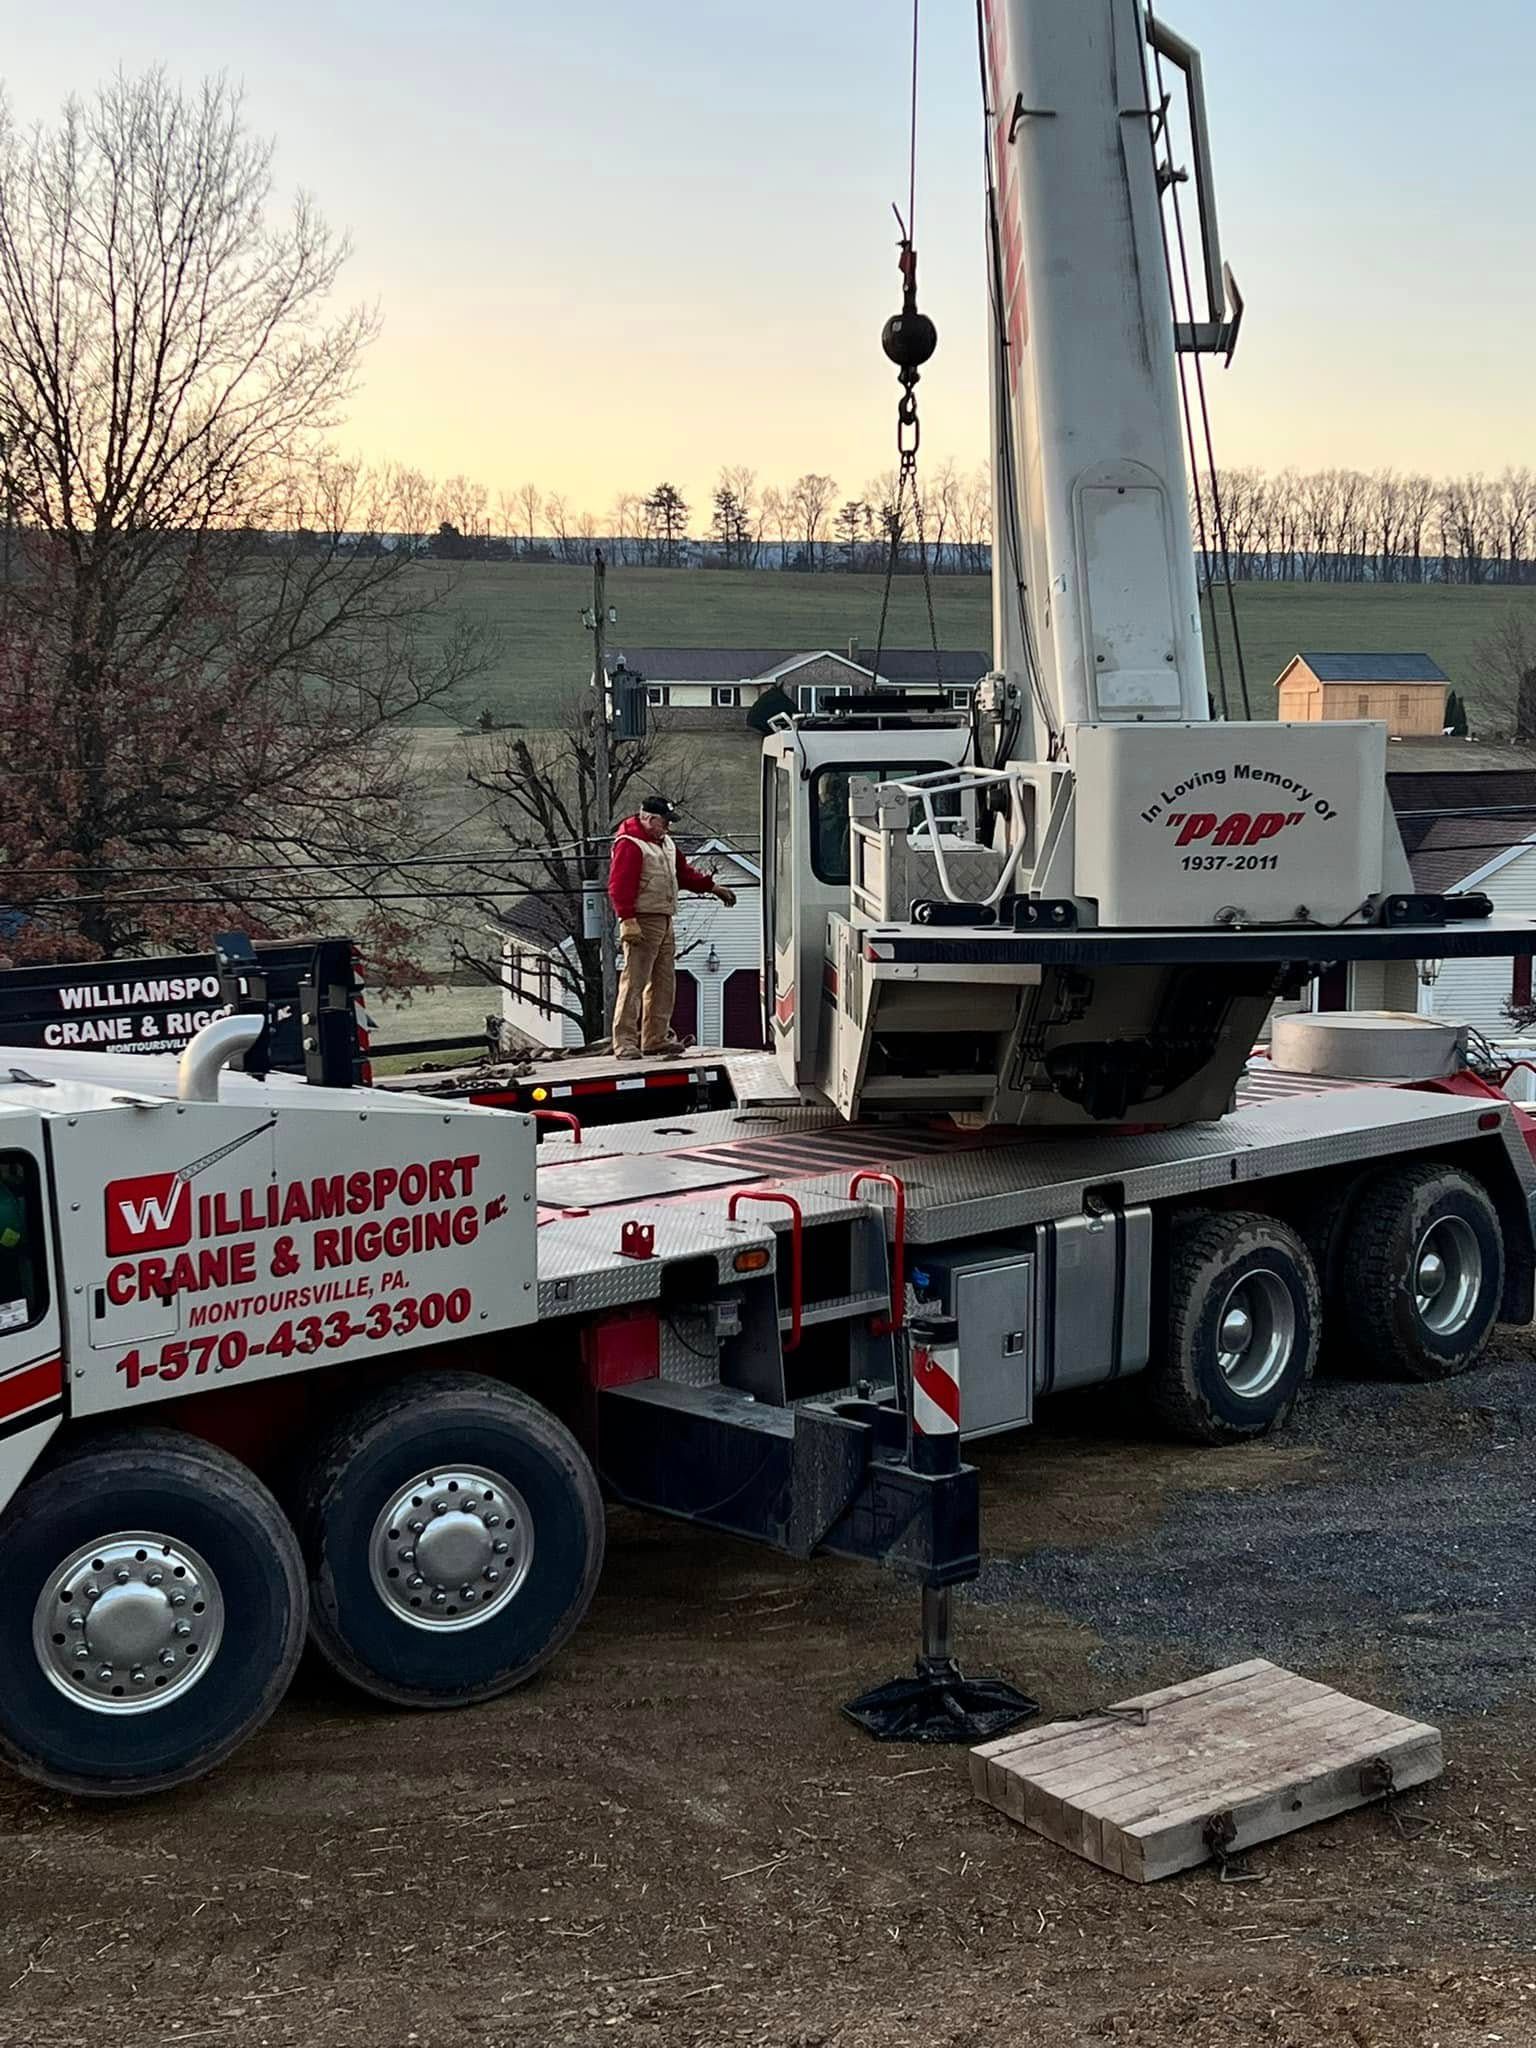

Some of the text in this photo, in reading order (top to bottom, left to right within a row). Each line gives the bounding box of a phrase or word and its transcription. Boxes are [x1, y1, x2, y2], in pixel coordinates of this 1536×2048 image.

[1141, 764, 1338, 823] In Loving Memory Of
[1165, 812, 1306, 847] "PAP"
[1180, 855, 1279, 871] 1937-2011
[44, 1017, 133, 1046] CRANE
[140, 1015, 160, 1037] &
[106, 1242, 257, 1306] CRANE
[270, 1236, 300, 1278] &
[313, 1205, 480, 1271] RIGGING
[188, 1269, 410, 1329] MONTOURSVILLE, PA.
[115, 1288, 472, 1389] 1-570-433-3300
